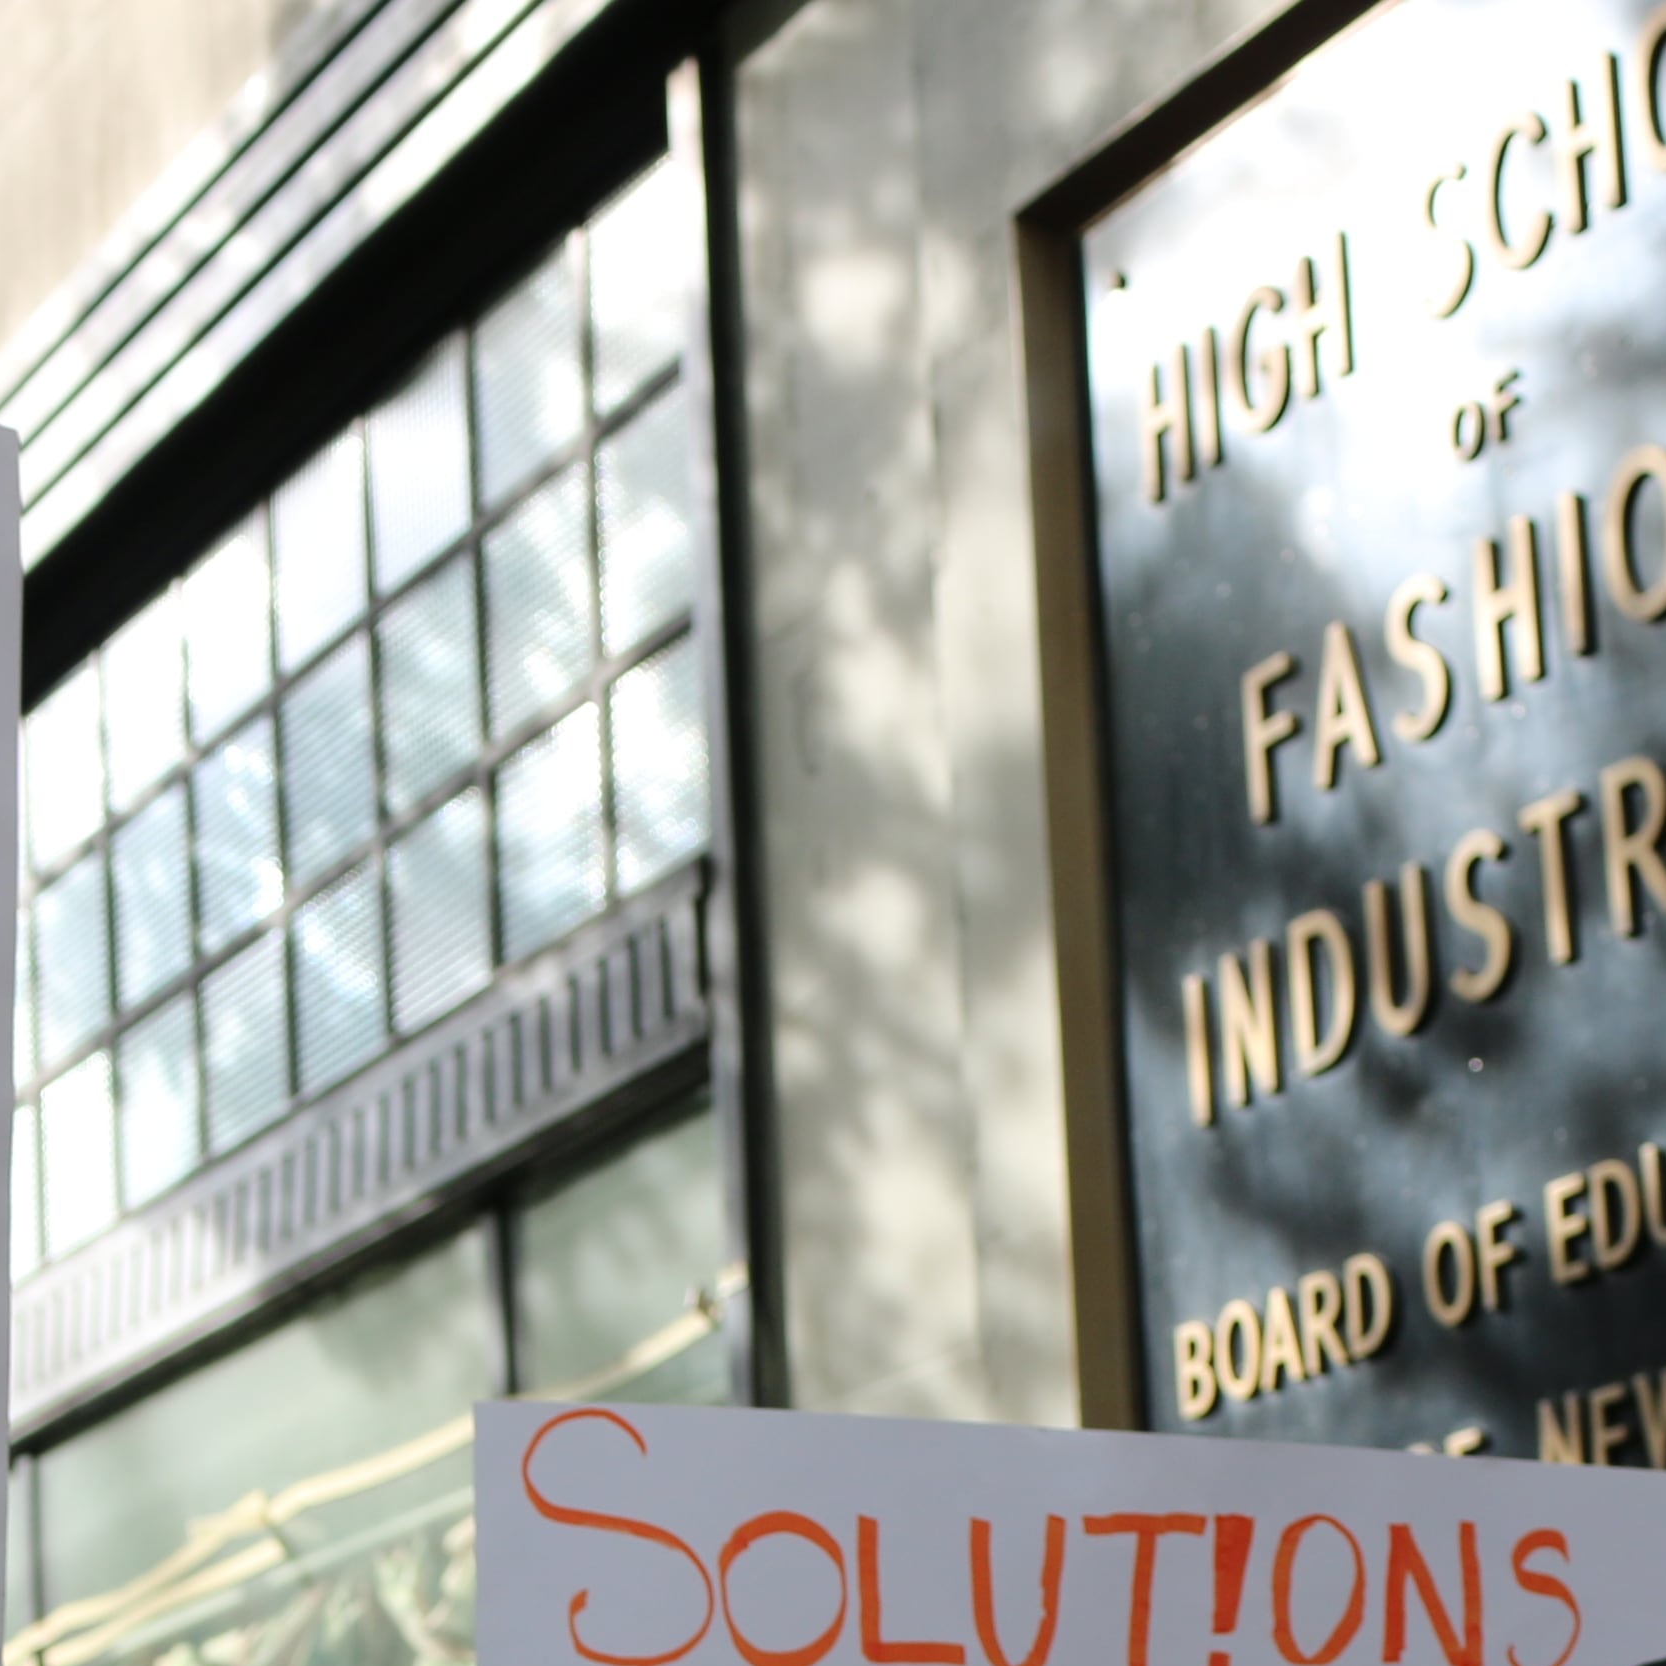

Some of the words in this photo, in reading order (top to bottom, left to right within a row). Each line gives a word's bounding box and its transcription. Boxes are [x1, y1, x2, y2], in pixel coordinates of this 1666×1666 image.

[1145, 231, 1354, 503] HIGH
[1451, 370, 1522, 462] OF
[1173, 1252, 1396, 1421] BOARD
[1422, 1200, 1524, 1328] OF
